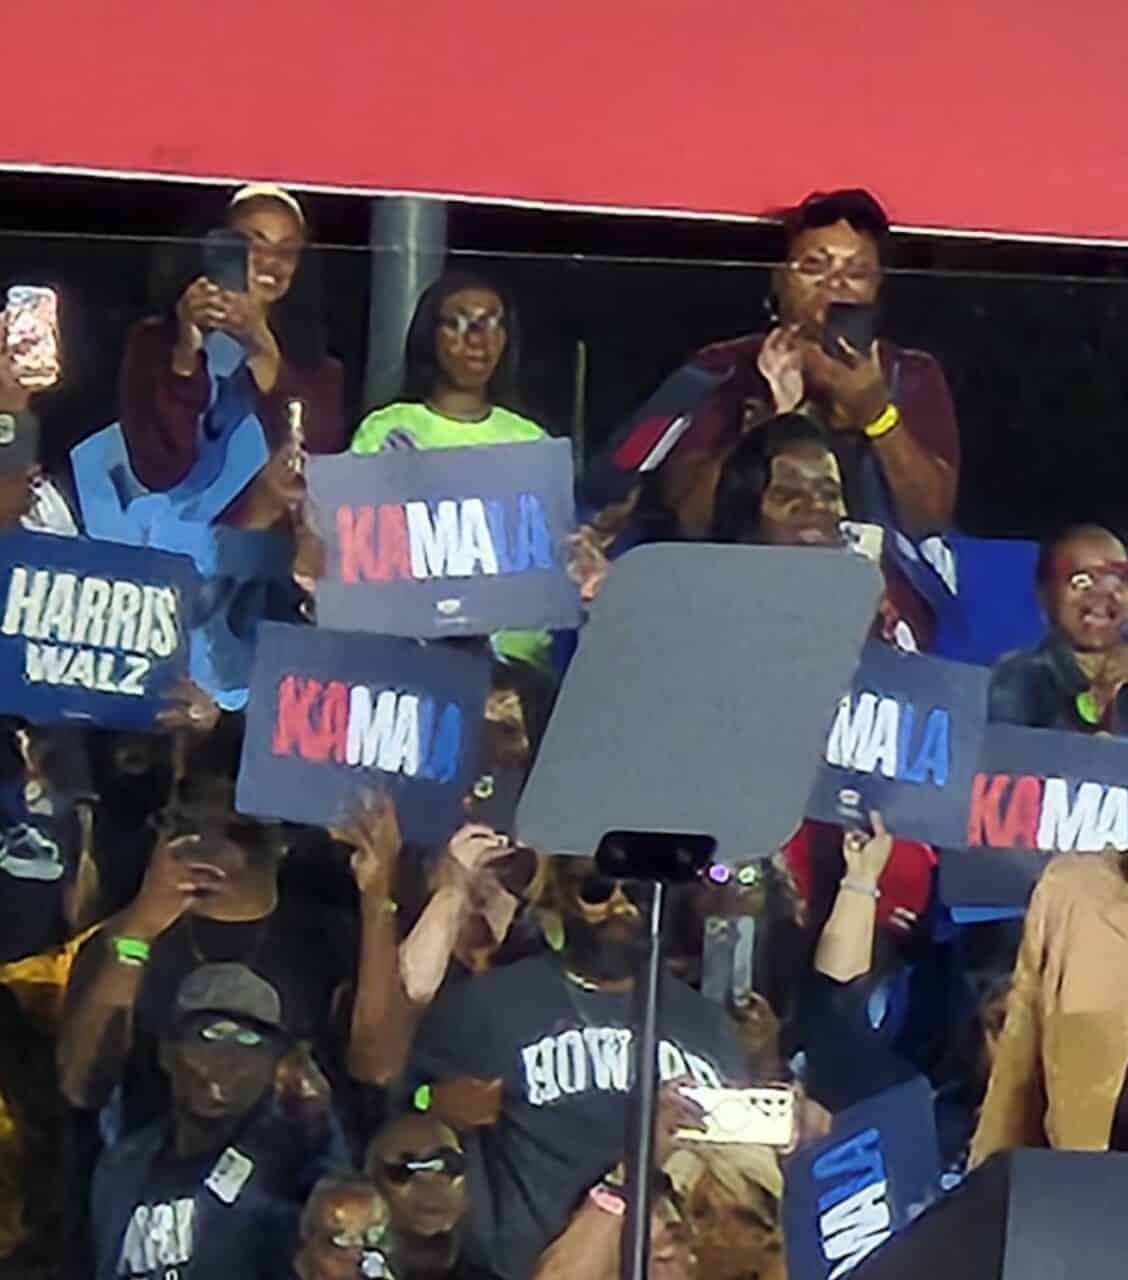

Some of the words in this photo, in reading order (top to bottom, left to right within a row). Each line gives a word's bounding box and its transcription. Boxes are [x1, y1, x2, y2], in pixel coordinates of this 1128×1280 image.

[336, 495, 553, 585] KAMALA
[1, 567, 179, 657] HARRIS
[26, 641, 150, 695] WALZ
[272, 673, 461, 784] KAMALA
[826, 692, 949, 787] MALA
